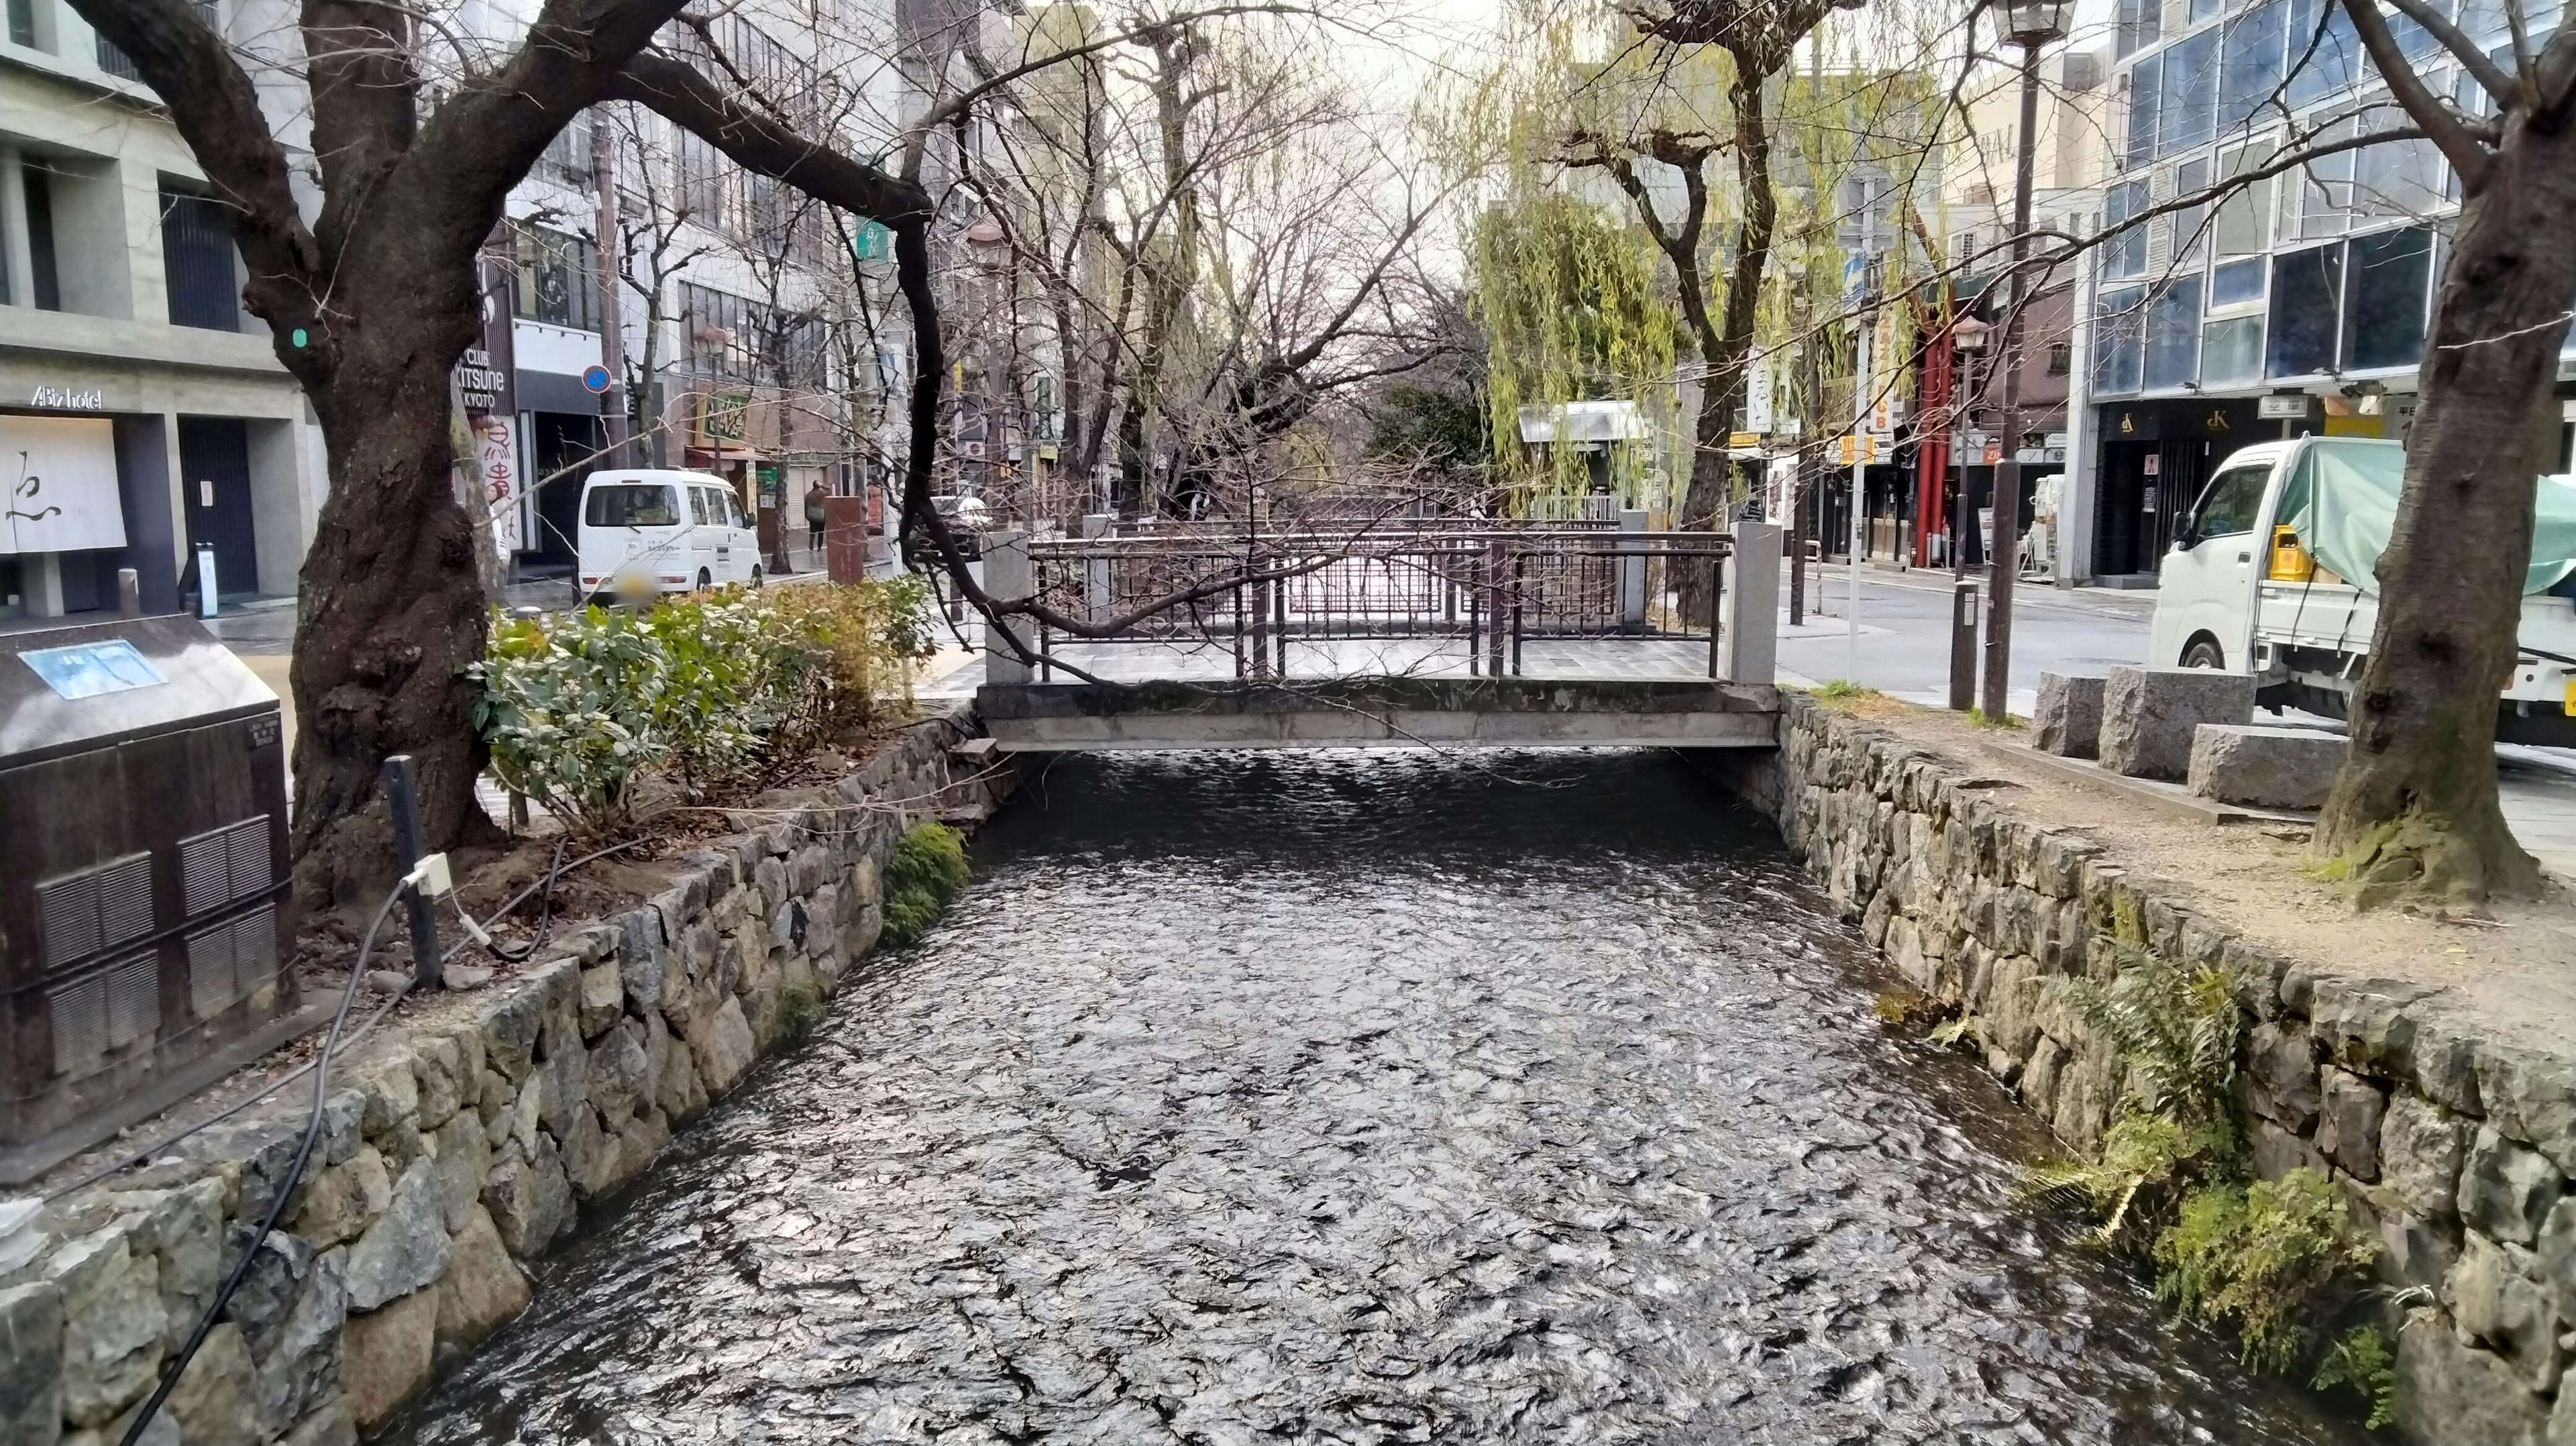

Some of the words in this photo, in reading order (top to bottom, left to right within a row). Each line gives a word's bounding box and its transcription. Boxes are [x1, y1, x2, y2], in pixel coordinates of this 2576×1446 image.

[466, 348, 489, 366] CLUB
[66, 388, 102, 410] hotel
[464, 392, 495, 408] KYOTO
